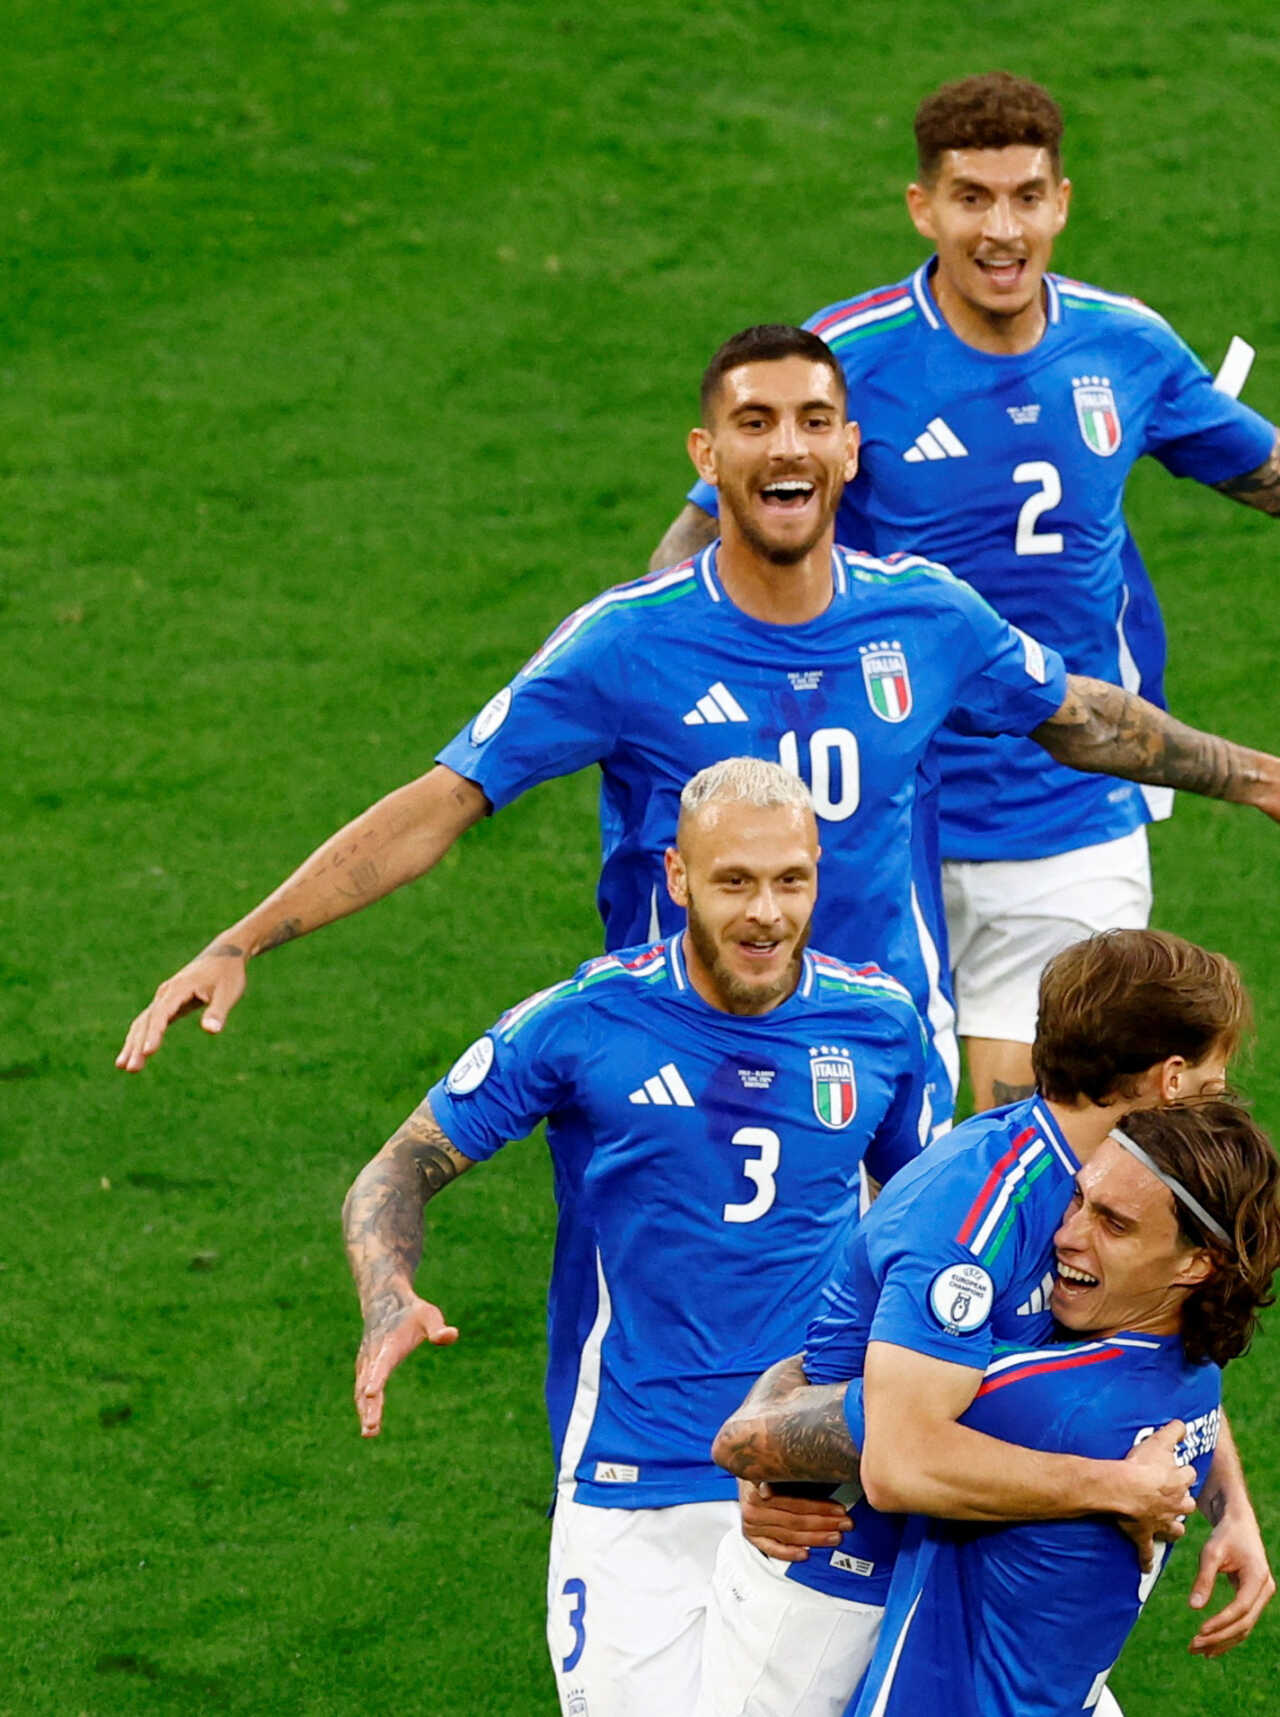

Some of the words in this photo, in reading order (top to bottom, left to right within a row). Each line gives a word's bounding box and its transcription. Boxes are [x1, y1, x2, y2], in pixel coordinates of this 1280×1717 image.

[1013, 461, 1063, 555] 2
[778, 727, 861, 822] 10
[815, 1062, 851, 1078] ITALIA
[723, 1127, 780, 1223] 3
[562, 1577, 586, 1673] 3
